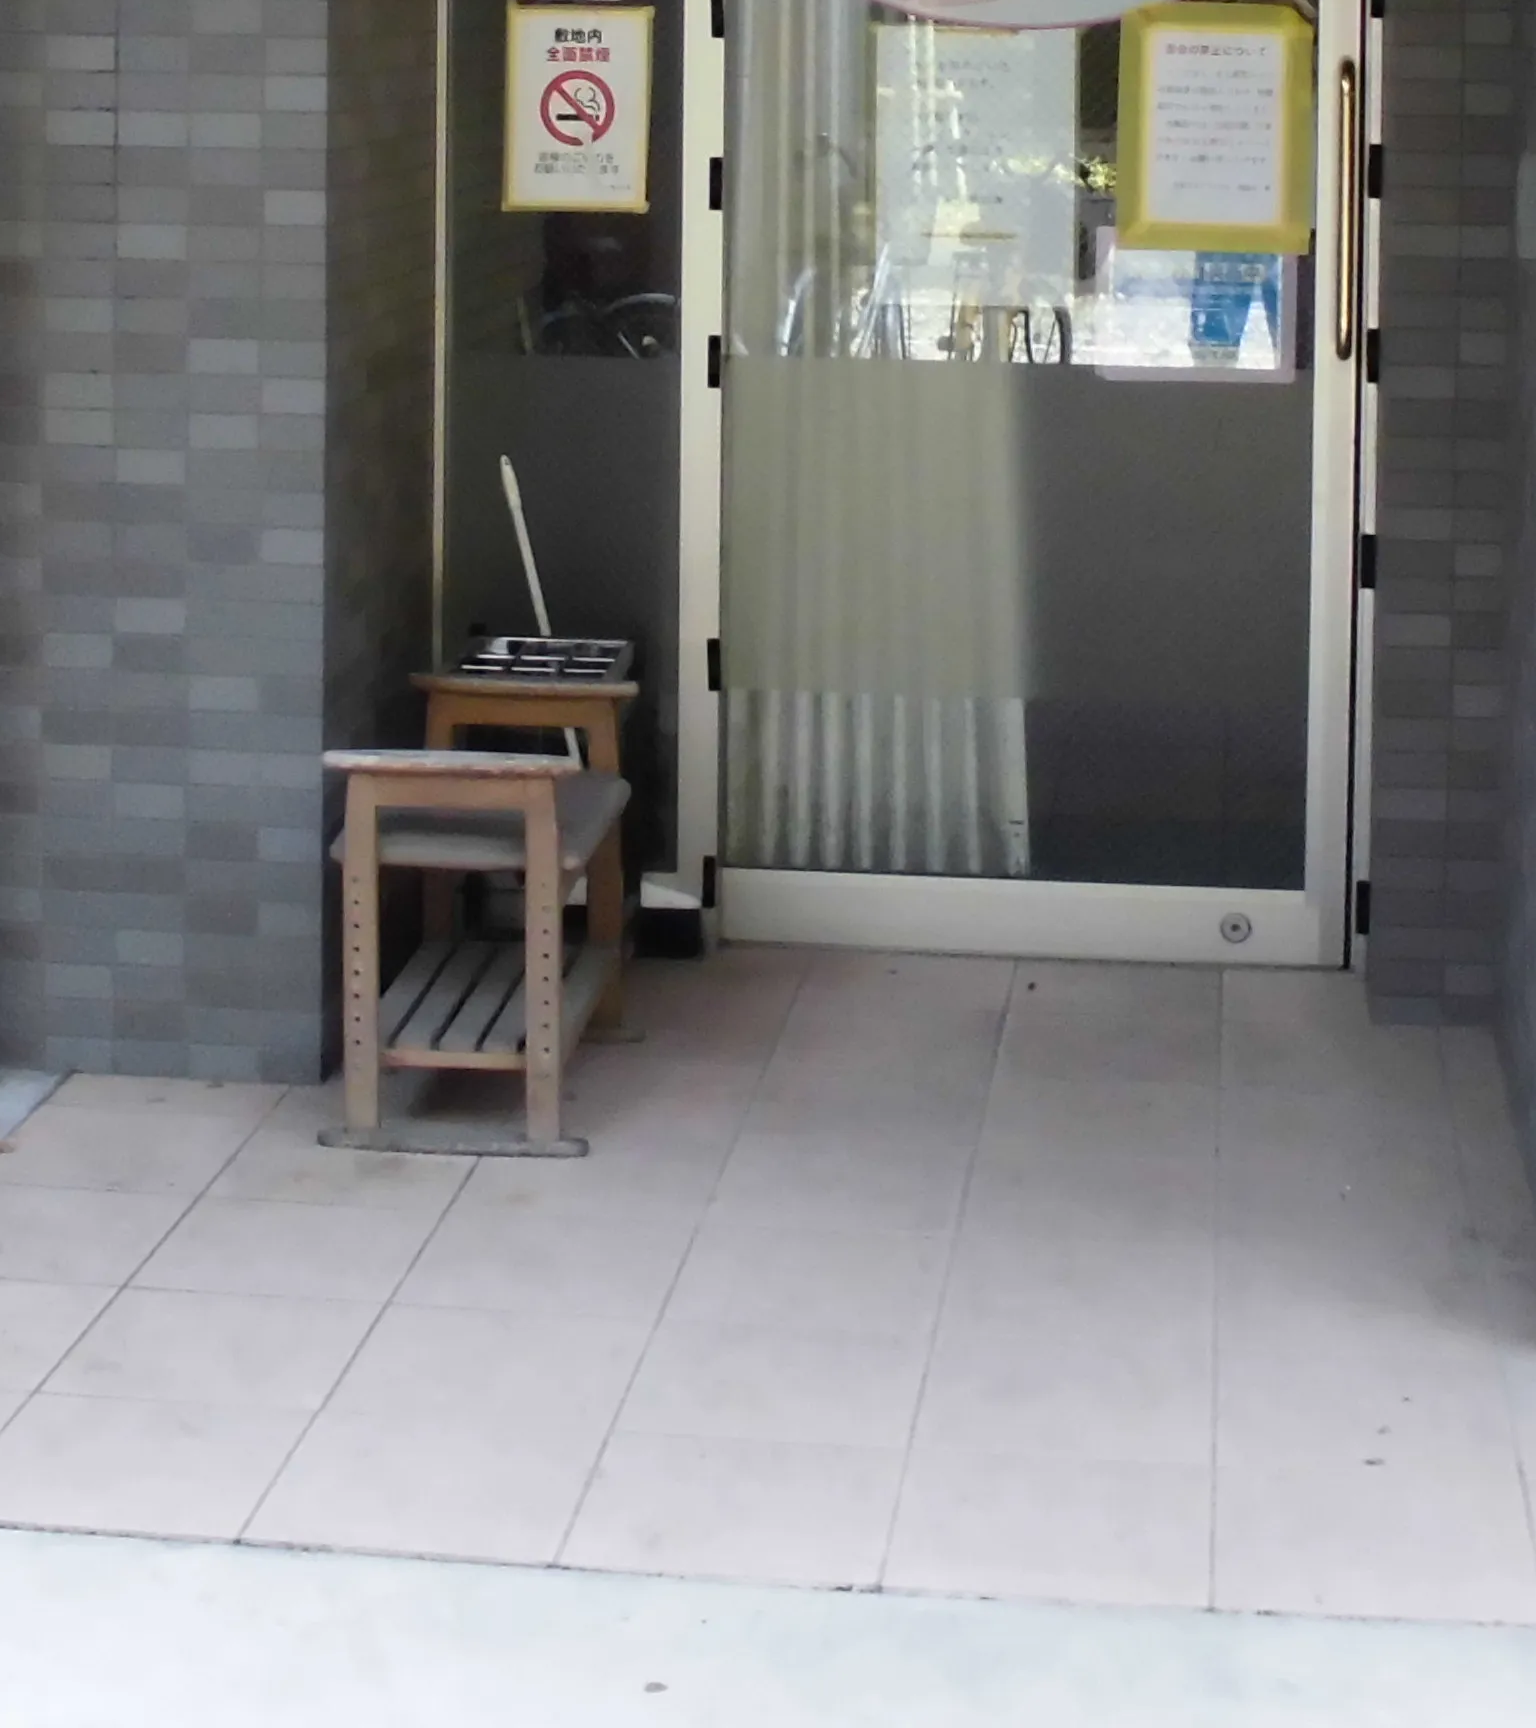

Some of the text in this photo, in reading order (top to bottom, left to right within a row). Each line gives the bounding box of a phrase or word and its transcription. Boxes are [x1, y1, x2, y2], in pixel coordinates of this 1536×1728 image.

[554, 28, 603, 44] 敷地内
[546, 47, 611, 62] 全面禁煙
